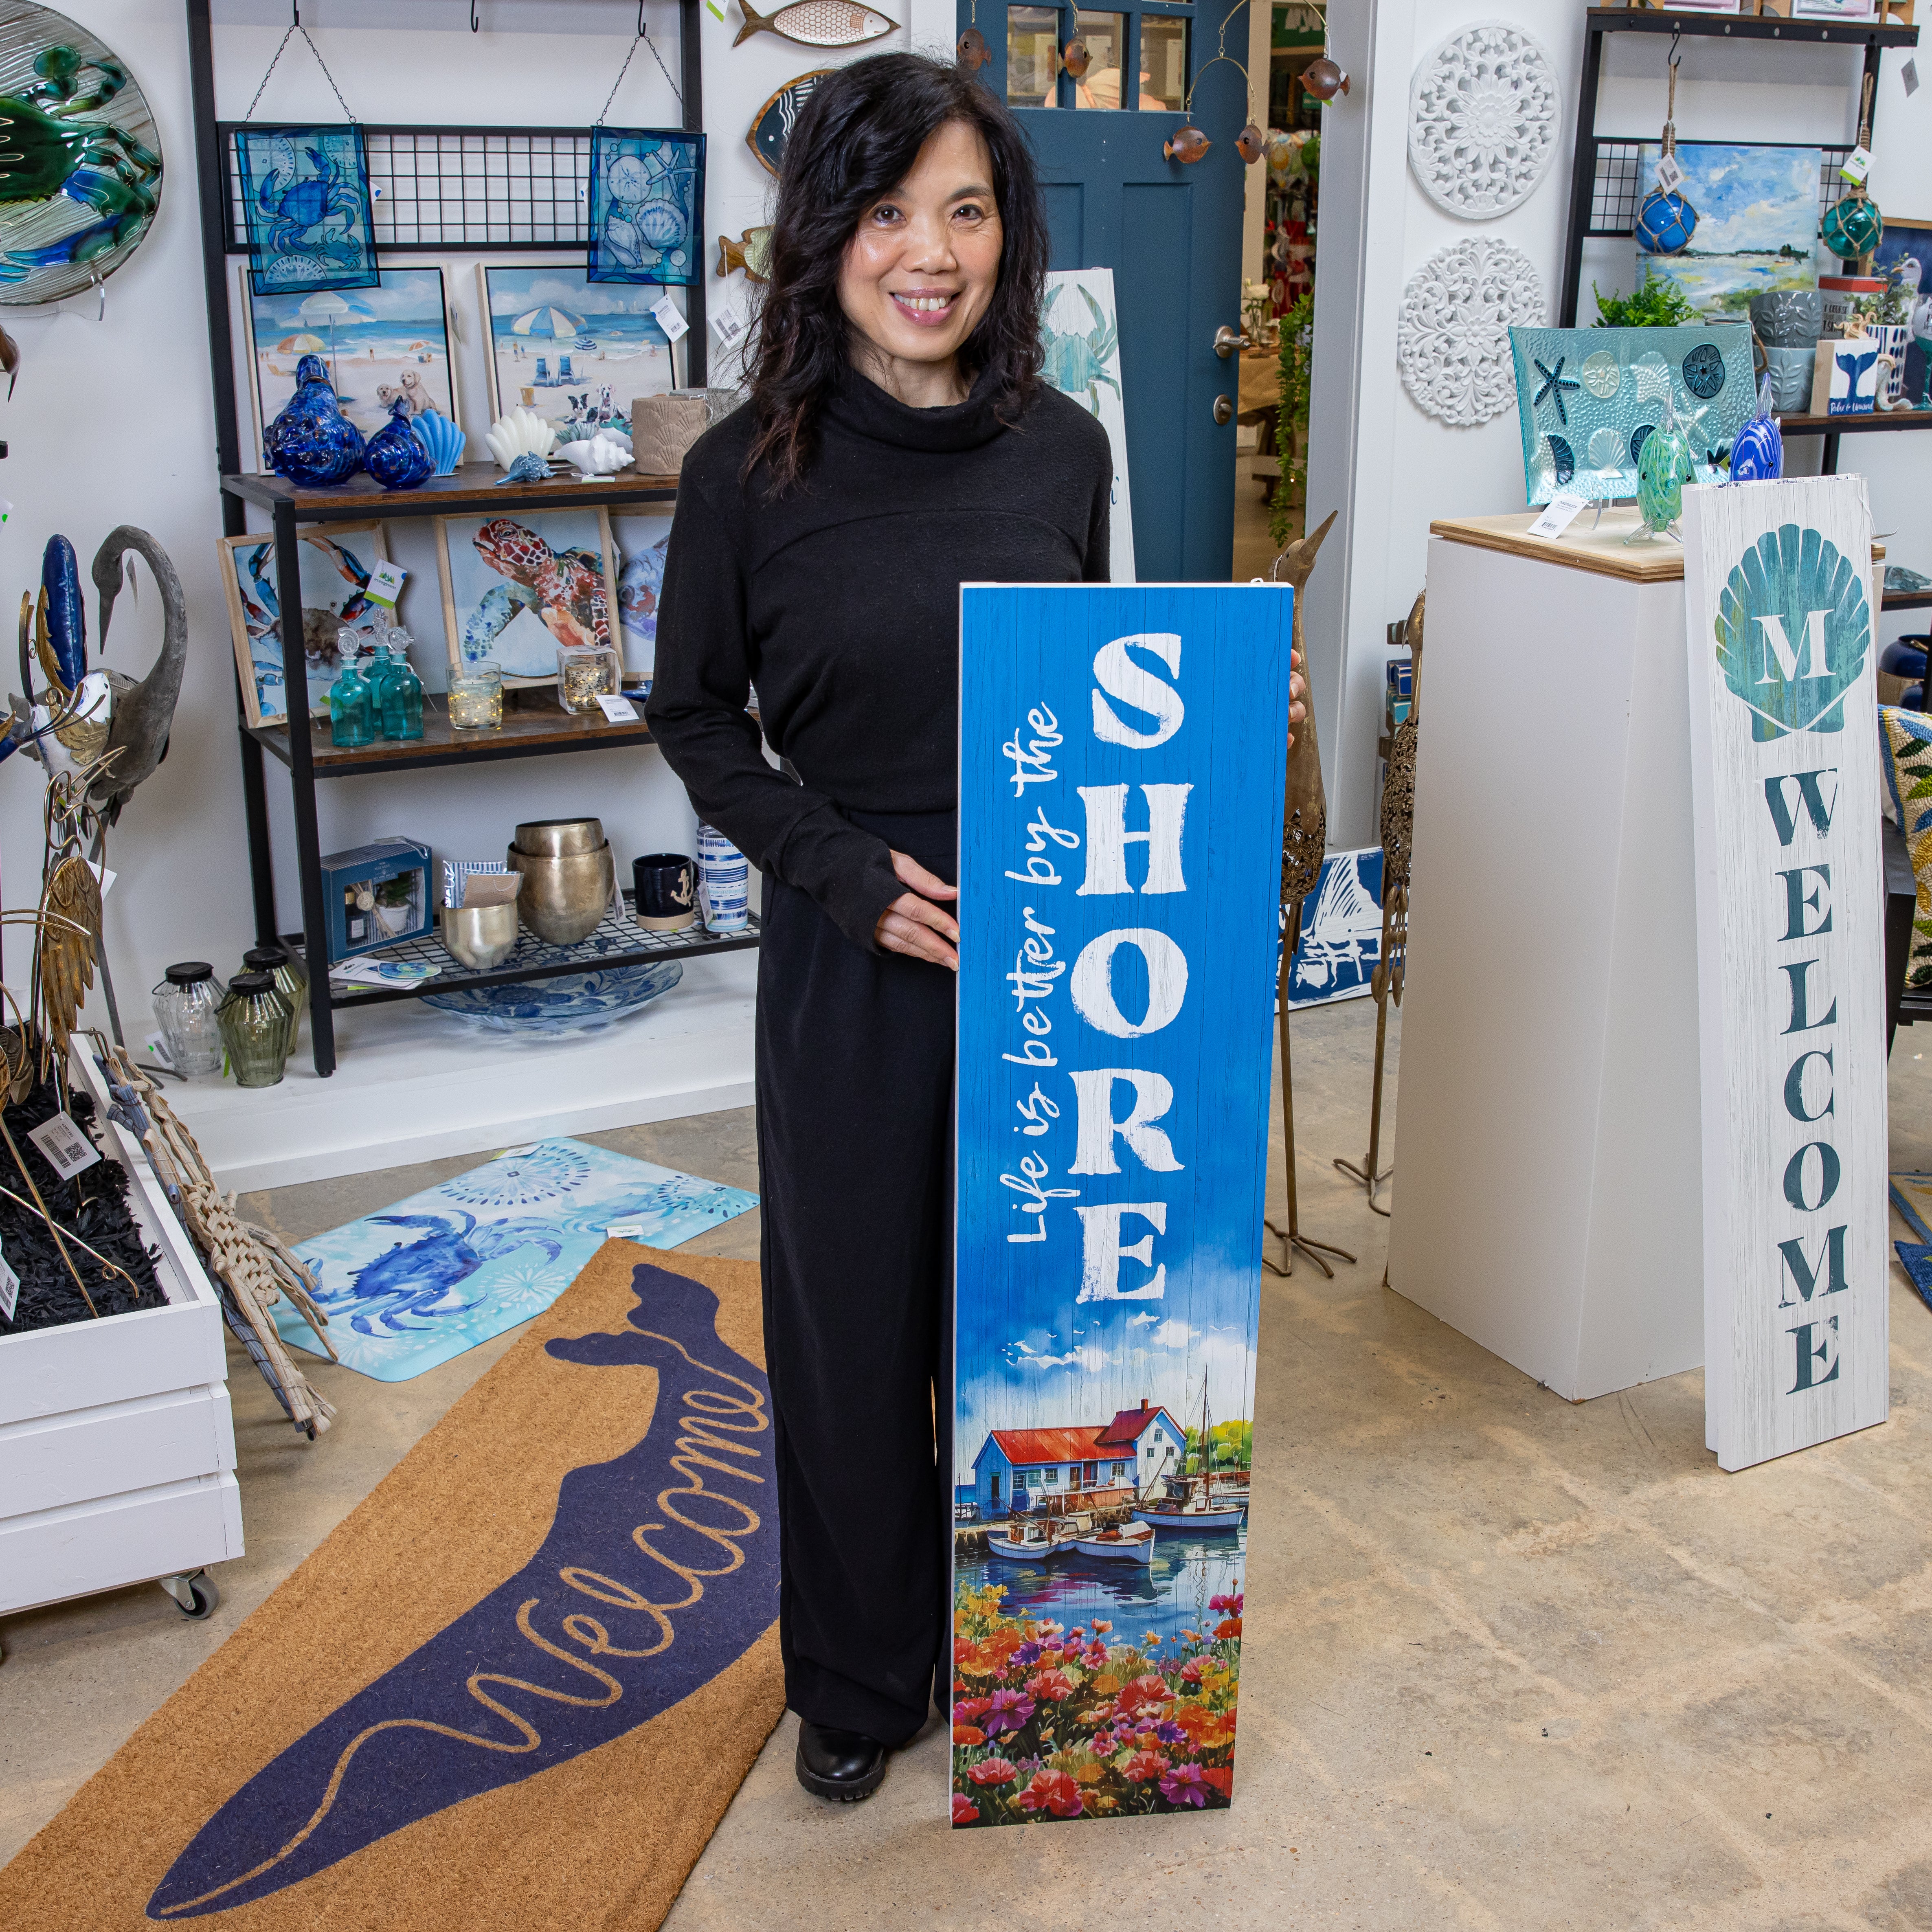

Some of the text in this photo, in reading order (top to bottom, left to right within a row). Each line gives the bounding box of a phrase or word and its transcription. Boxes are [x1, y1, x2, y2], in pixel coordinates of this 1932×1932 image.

[1752, 608, 1838, 686] M
[999, 701, 1081, 1243] Life is better by the
[1067, 632, 1195, 1304] SHORE
[1763, 767, 1848, 1396] WELCOME
